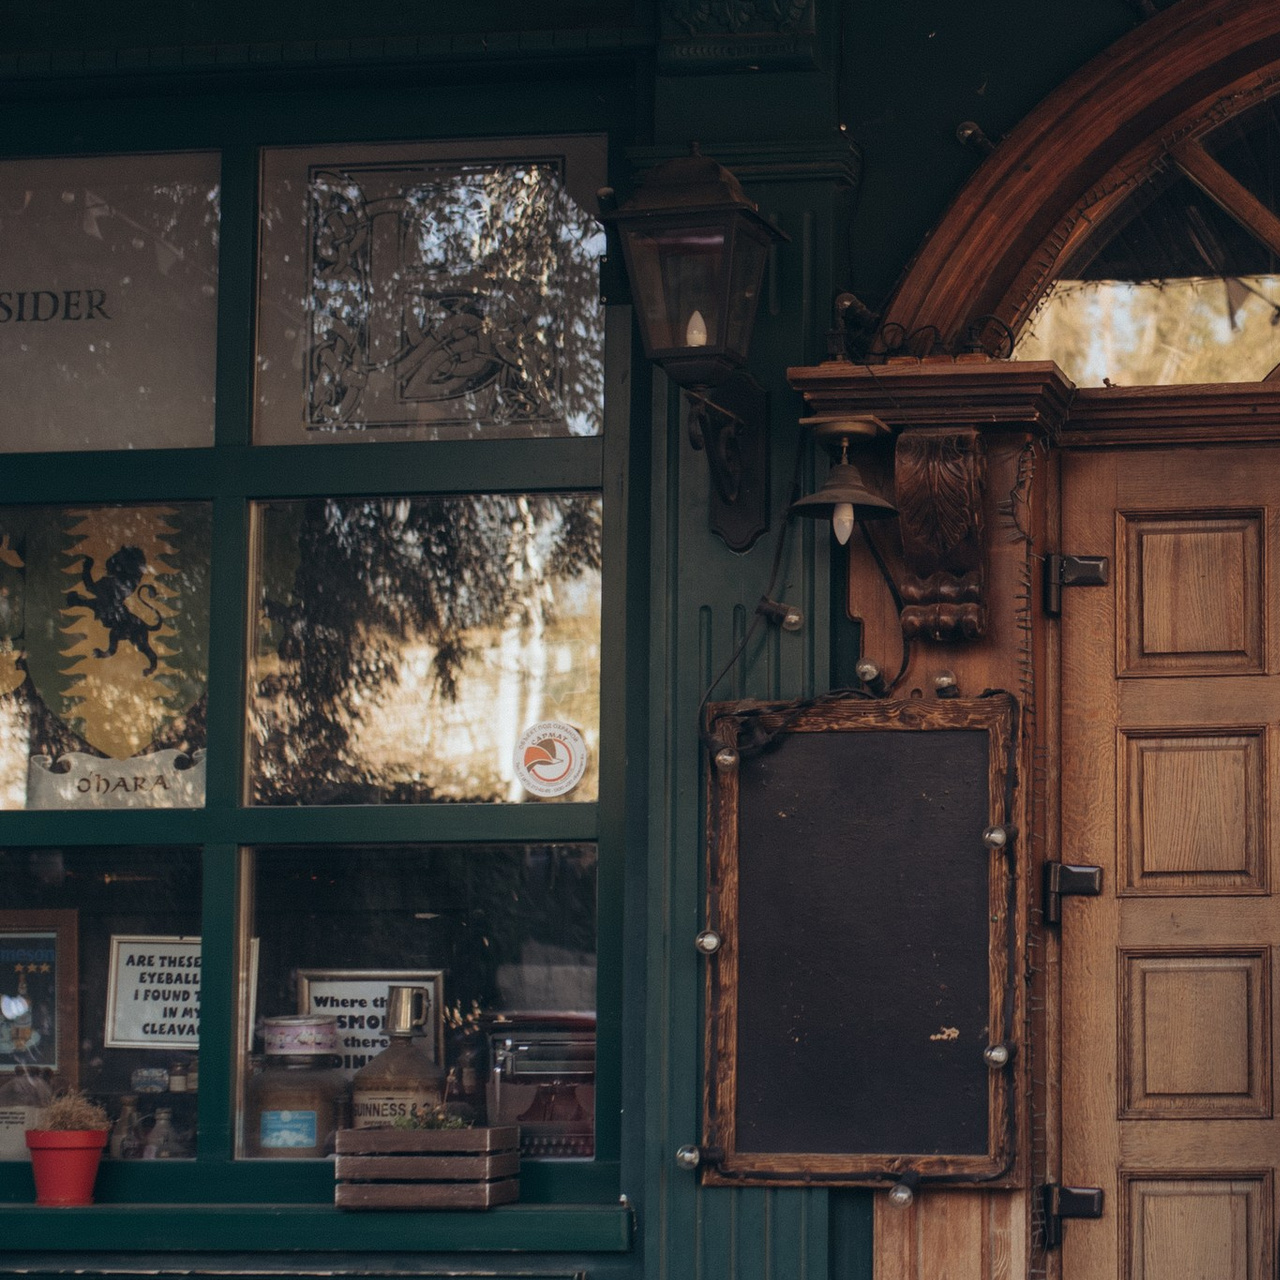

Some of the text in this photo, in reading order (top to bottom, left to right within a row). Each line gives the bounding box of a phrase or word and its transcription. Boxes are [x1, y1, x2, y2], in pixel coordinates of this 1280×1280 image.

[126, 954, 202, 968] ARE THESE
[134, 989, 139, 1001] I
[143, 989, 190, 1002] FOUND
[313, 996, 367, 1008] Where
[163, 1006, 178, 1018] IN
[343, 1036, 388, 1048] there
[331, 1055, 375, 1069] DIN
